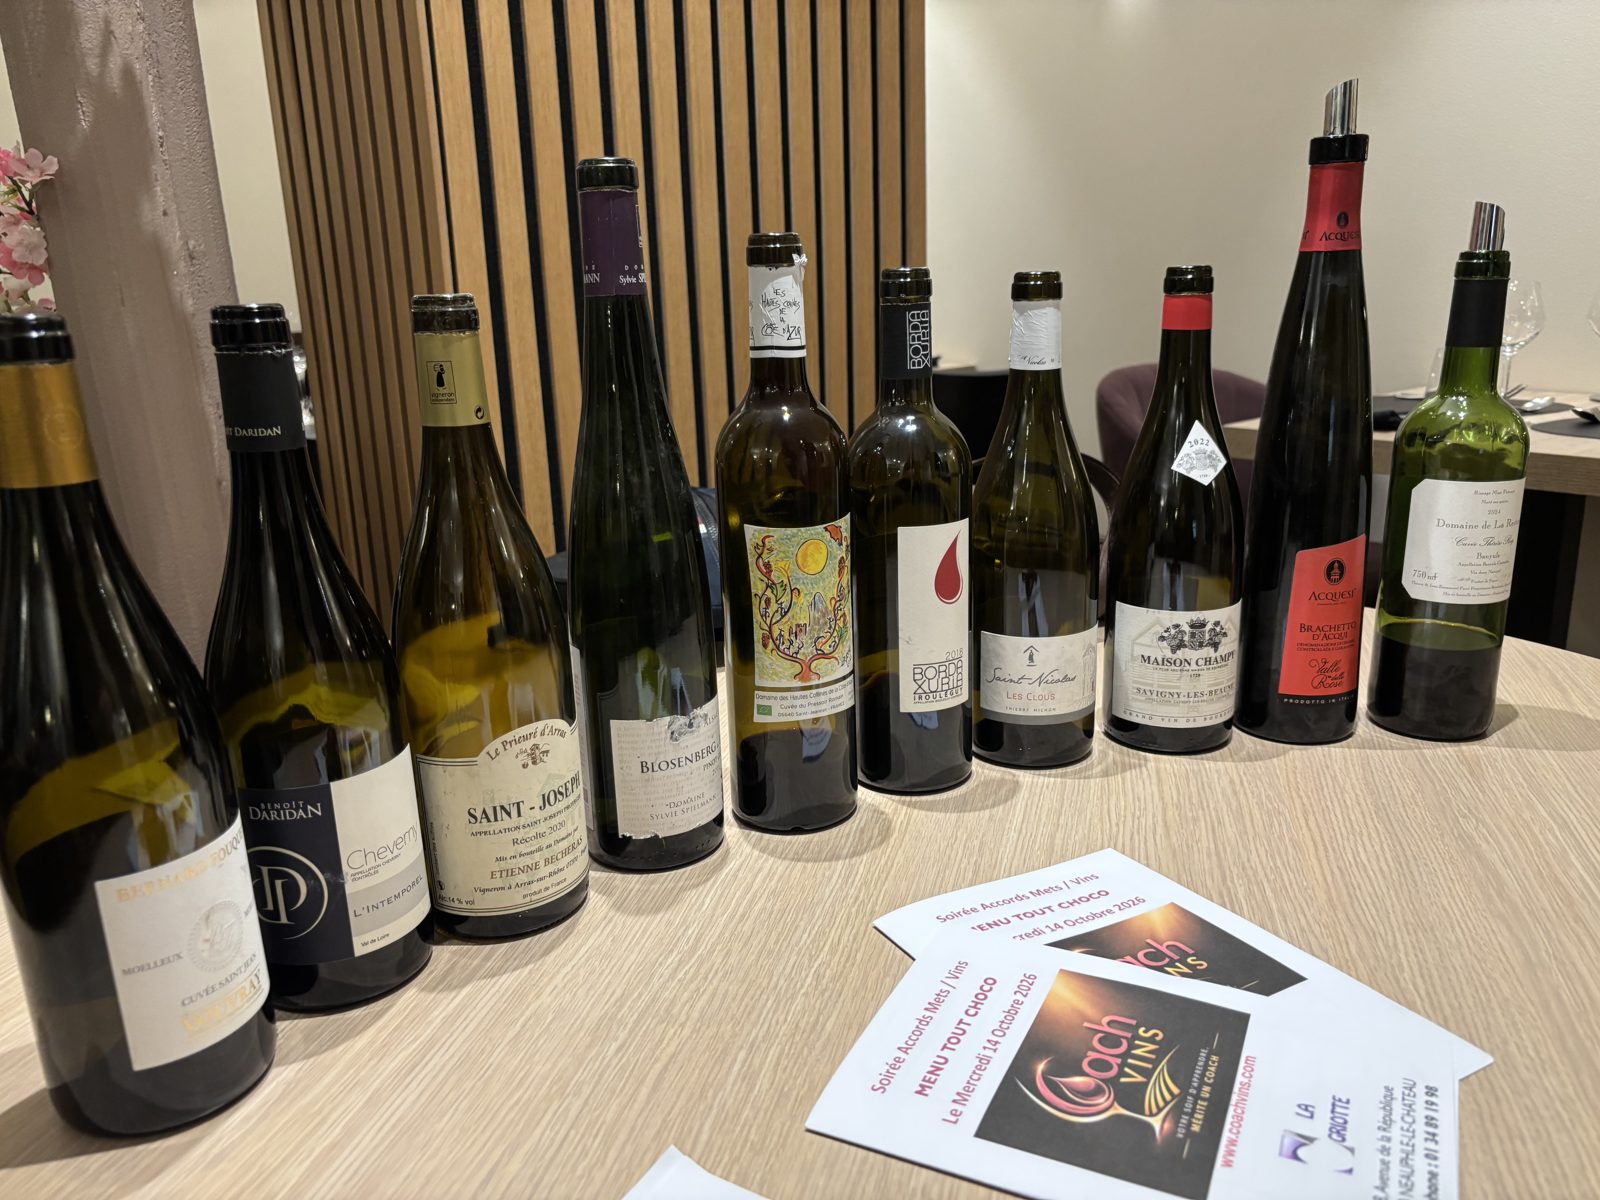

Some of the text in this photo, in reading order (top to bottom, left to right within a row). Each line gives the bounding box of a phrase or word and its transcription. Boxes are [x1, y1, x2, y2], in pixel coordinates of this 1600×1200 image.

[619, 274, 637, 285] Sylvie
[909, 310, 922, 370] BORDA
[234, 425, 281, 436] DARIDAN
[1187, 437, 1210, 448] 2022
[1436, 518, 1504, 529] Domaine de La
[1412, 569, 1427, 579] 750
[1299, 620, 1357, 633] BRACHETTO
[1312, 632, 1348, 641] D'ACQUI
[913, 659, 963, 680] BORDA
[1140, 654, 1192, 668] MAISON
[1308, 657, 1343, 674] Valle
[985, 667, 1077, 687] Saint Nicolas
[1310, 673, 1343, 690] Rose
[755, 693, 778, 701] Domaine
[485, 723, 568, 761] Le Prieuré d'Arras
[640, 741, 716, 774] BLOSENBERG
[260, 800, 304, 810] BENOÎT
[467, 800, 525, 825] SAINT
[539, 769, 581, 812] JOSEPH
[669, 791, 705, 809] DOMAINE
[249, 802, 322, 821] DARIDAN
[649, 810, 679, 821] SYLVIE
[470, 807, 564, 838] APPELLATION SAINT JOSEPH
[512, 819, 566, 847] Récolte 2020
[490, 861, 541, 880] ETIENNE
[543, 835, 583, 867] BECHERAS
[494, 854, 508, 863] Mis
[350, 863, 382, 878] APPELLATION
[353, 873, 423, 918] L'INTEMPOREL
[473, 885, 506, 896] Vigneron
[507, 882, 512, 890] à
[522, 889, 543, 900] produit
[551, 877, 567, 889] France
[936, 906, 980, 923] Soirée
[981, 893, 1030, 911] Accords
[1028, 884, 1063, 898] Mets
[1069, 872, 1100, 885] Vins
[465, 898, 475, 906] vol
[971, 889, 1110, 932] ENU TOUT CHOCO
[1045, 896, 1146, 933] 14 Octobre 2026
[377, 932, 390, 943] Loire
[121, 952, 184, 978] MOELLEUX
[180, 981, 218, 1008] CUVÉE
[218, 965, 243, 990] SAINT
[871, 1054, 906, 1095] Soirée
[897, 1014, 934, 1055] Accords
[924, 989, 951, 1015] Mets
[947, 960, 969, 981] Vins
[914, 976, 998, 1098] MENU TOUT CHOCO
[941, 972, 1038, 1125] Le Mercredi 14 Octobre 2026
[1119, 1026, 1164, 1083] VINS
[1190, 1054, 1220, 1133] MÉRITE UN COACH
[1424, 1085, 1439, 1098] 98
[1220, 1055, 1257, 1169] www.coachvins.com
[1295, 1102, 1316, 1120] LA
[1377, 1085, 1398, 1134] République
[1424, 1100, 1439, 1112] 19
[1176, 1114, 1190, 1139] VOTRE
[1183, 1095, 1194, 1113] SOIF
[1327, 1094, 1350, 1143] GRIOTTE
[1424, 1114, 1439, 1129] 89
[1376, 1134, 1392, 1144] la
[1424, 1130, 1439, 1146] 34
[1376, 1144, 1391, 1157] de
[1424, 1147, 1439, 1161] 01
[1373, 1158, 1391, 1194] Avenue
